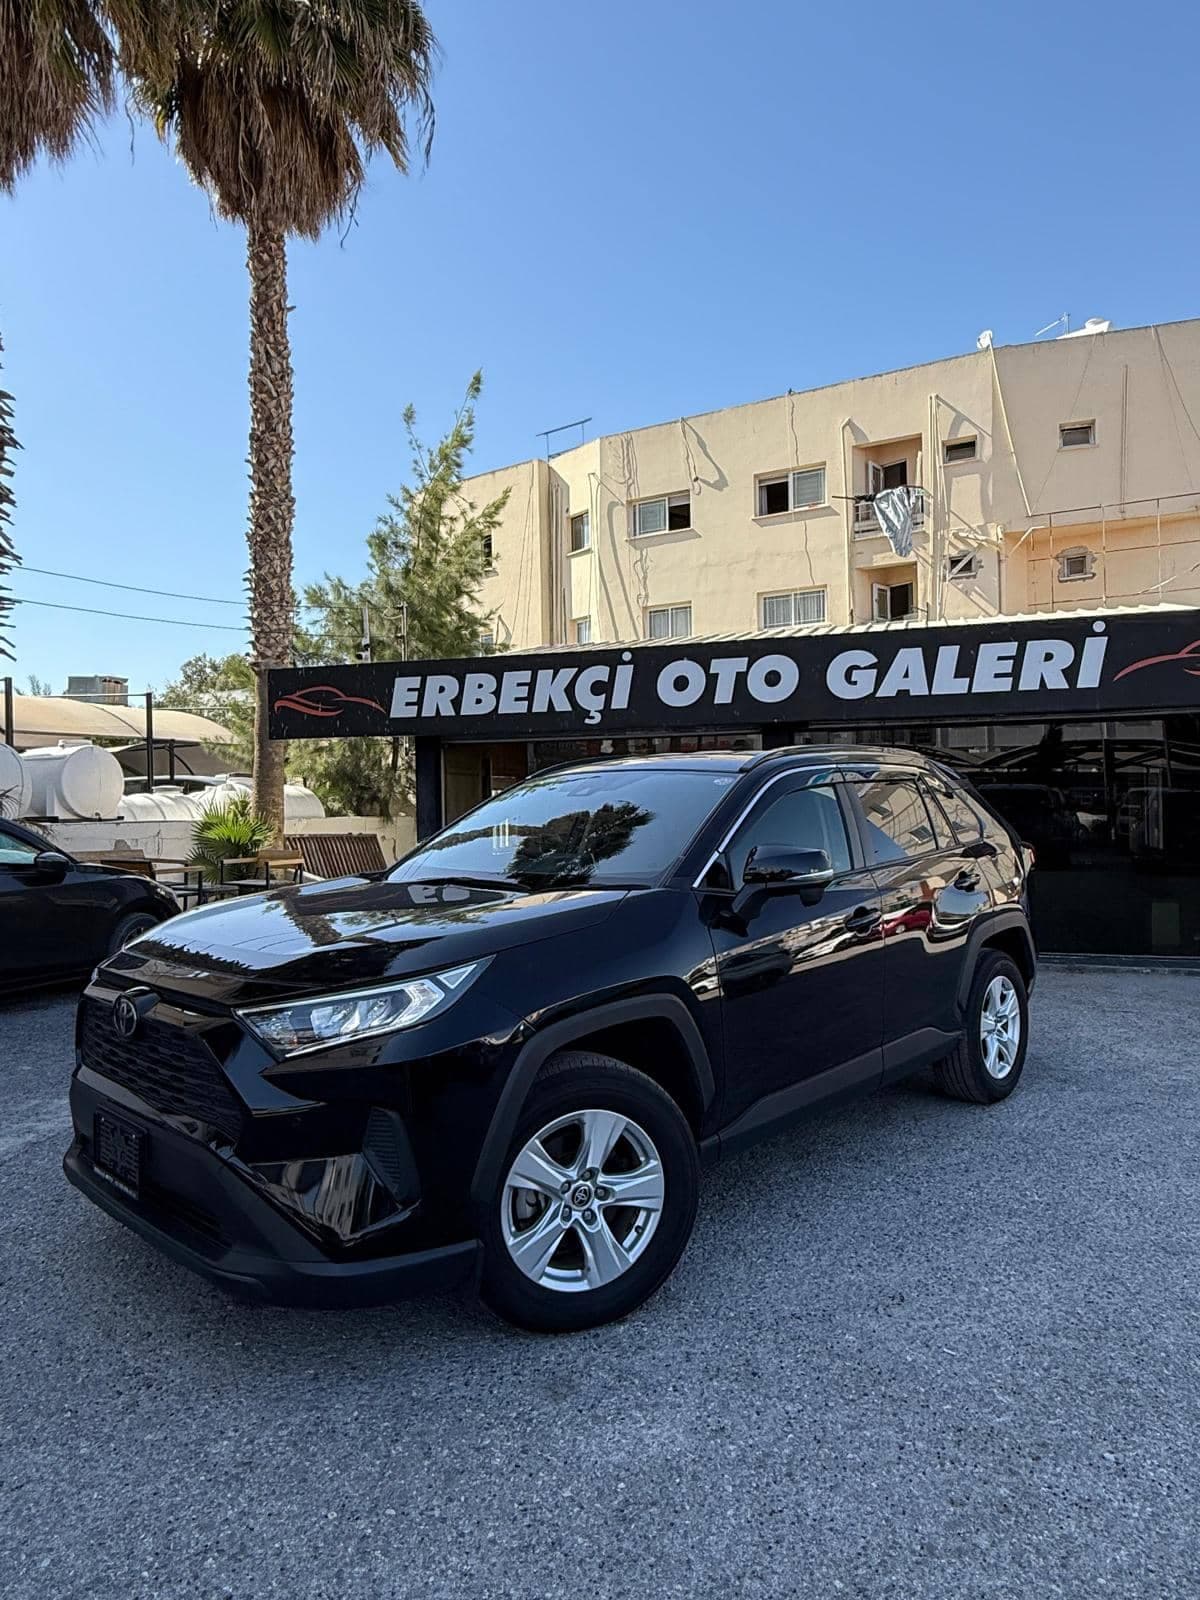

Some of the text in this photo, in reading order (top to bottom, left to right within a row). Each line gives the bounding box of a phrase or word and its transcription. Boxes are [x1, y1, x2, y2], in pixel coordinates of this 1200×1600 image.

[389, 620, 1109, 725] ERBEKÇİ OTO GALERİ
